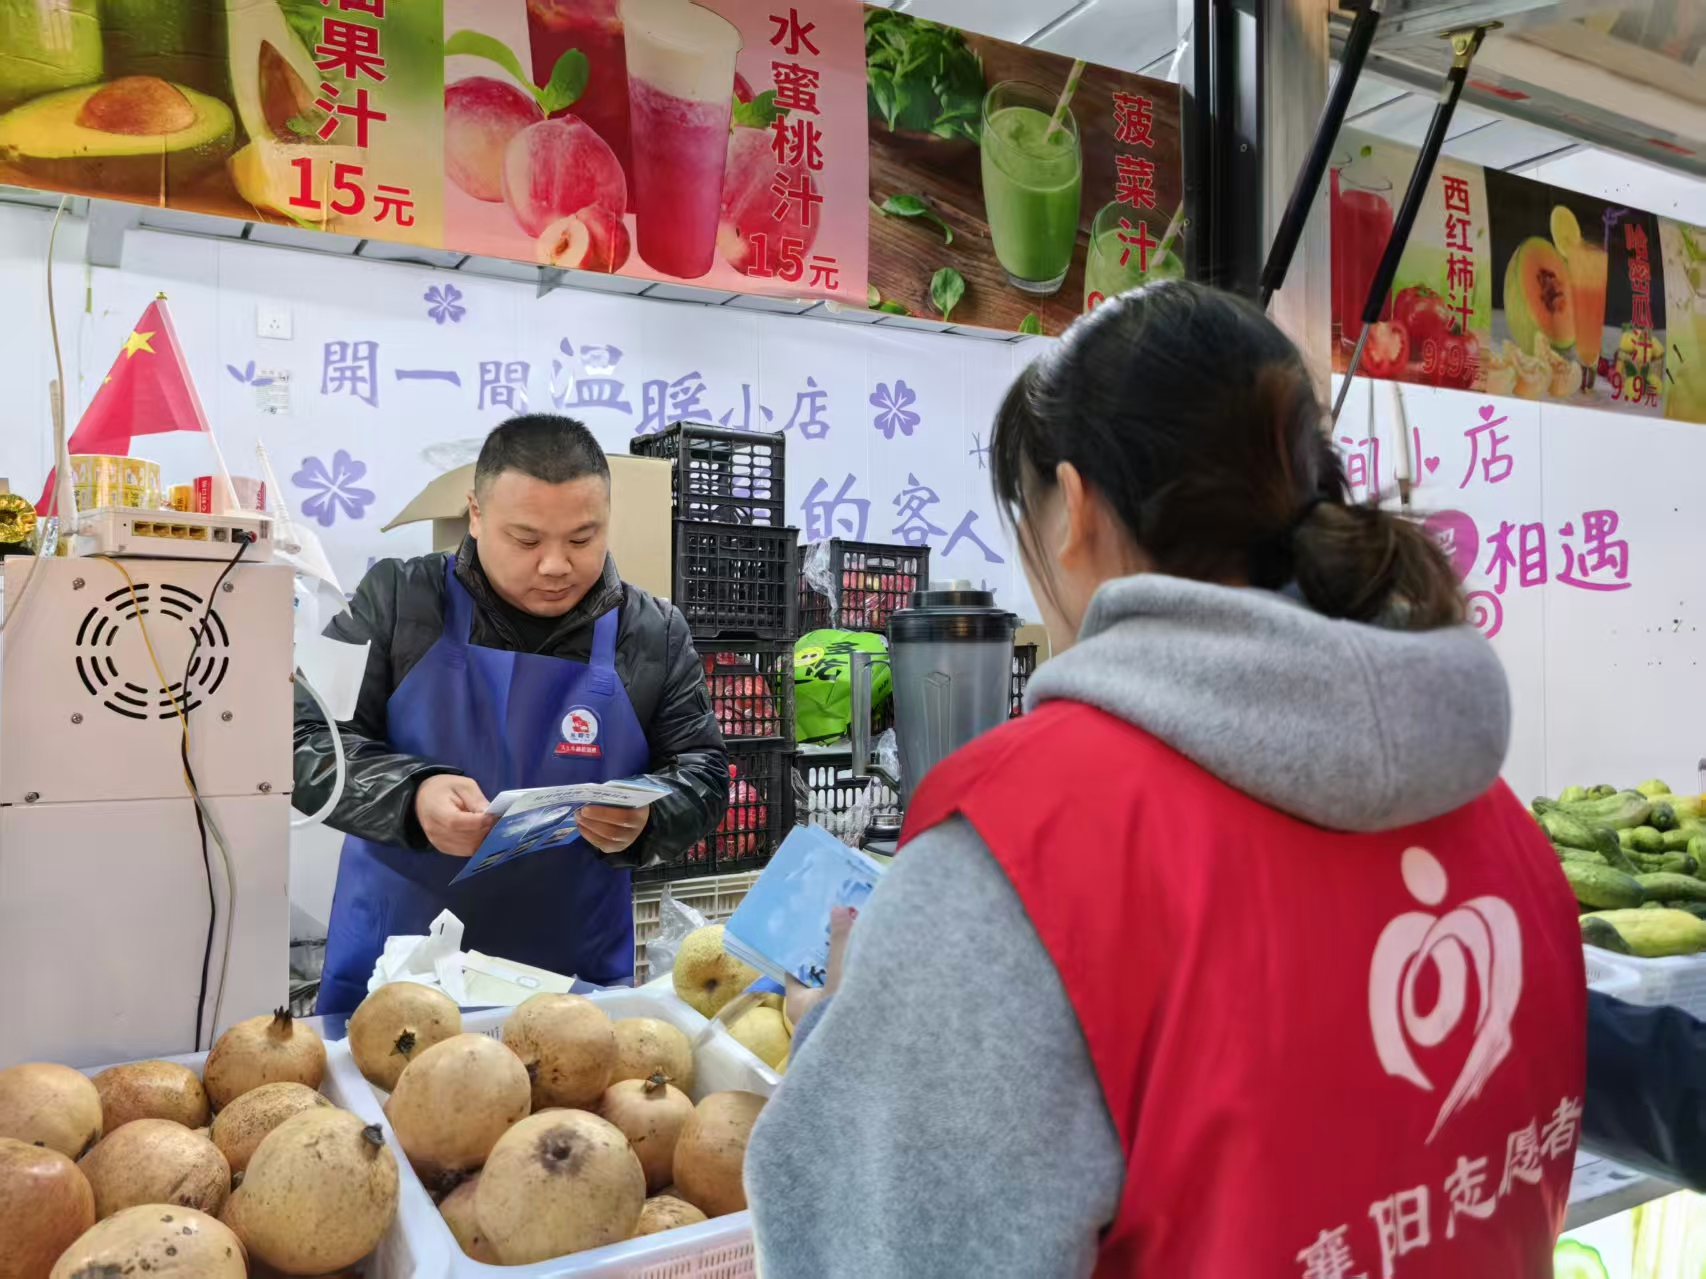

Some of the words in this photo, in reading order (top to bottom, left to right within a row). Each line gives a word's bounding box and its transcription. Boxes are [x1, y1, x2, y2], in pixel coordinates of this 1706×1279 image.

[288, 156, 415, 227] 15元
[768, 8, 824, 227] 水蜜桃汁
[1113, 91, 1159, 273] 菠菜汁
[748, 233, 840, 291] 15元
[1441, 175, 1475, 333] 西红柿汁
[1623, 223, 1655, 364] 哈密瓜汁
[1610, 375, 1658, 408] 9.9元
[1296, 1096, 1583, 1279] 襄阳志愿者
